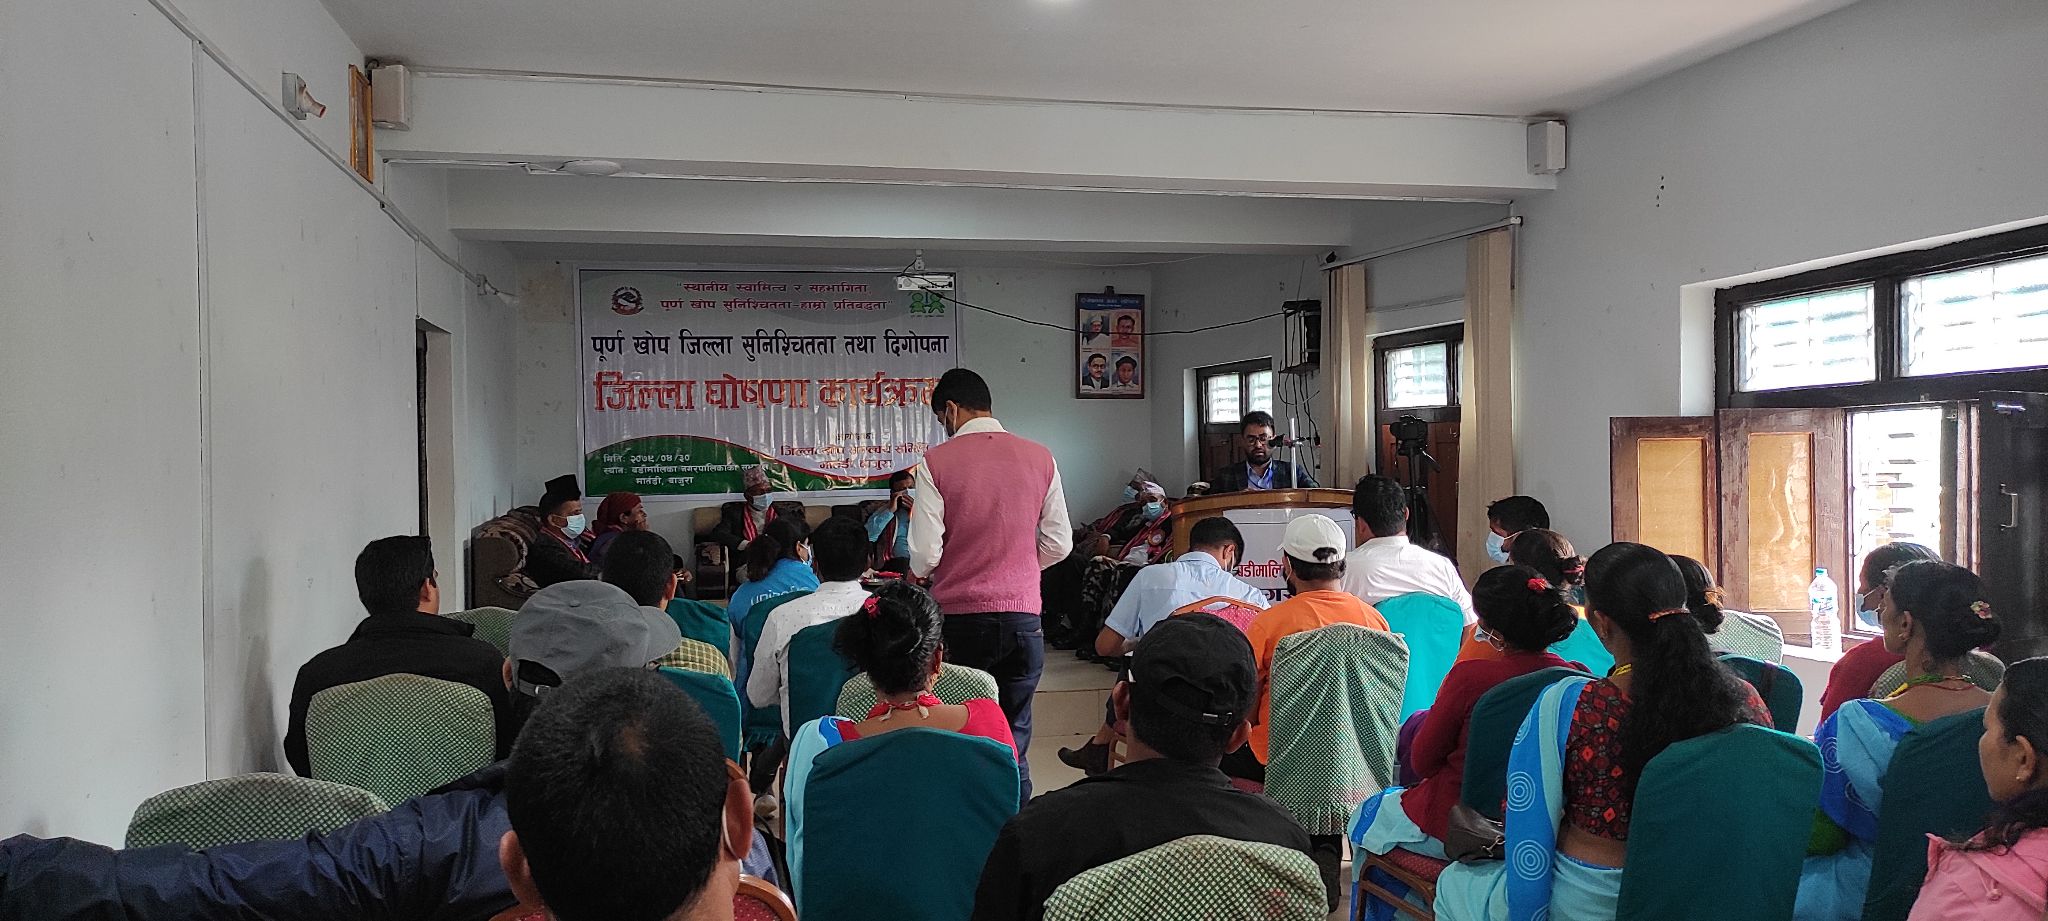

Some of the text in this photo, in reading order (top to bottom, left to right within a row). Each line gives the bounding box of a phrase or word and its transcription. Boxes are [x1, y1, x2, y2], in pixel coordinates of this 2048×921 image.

[793, 283, 802, 293] र
[689, 299, 716, 309] खोप
[591, 328, 949, 362] पूर्ण खोप जिल्ला सुनिश्चितता तथा दिगोपना
[593, 370, 697, 412] जिल्ला
[704, 373, 811, 409] घोषणा
